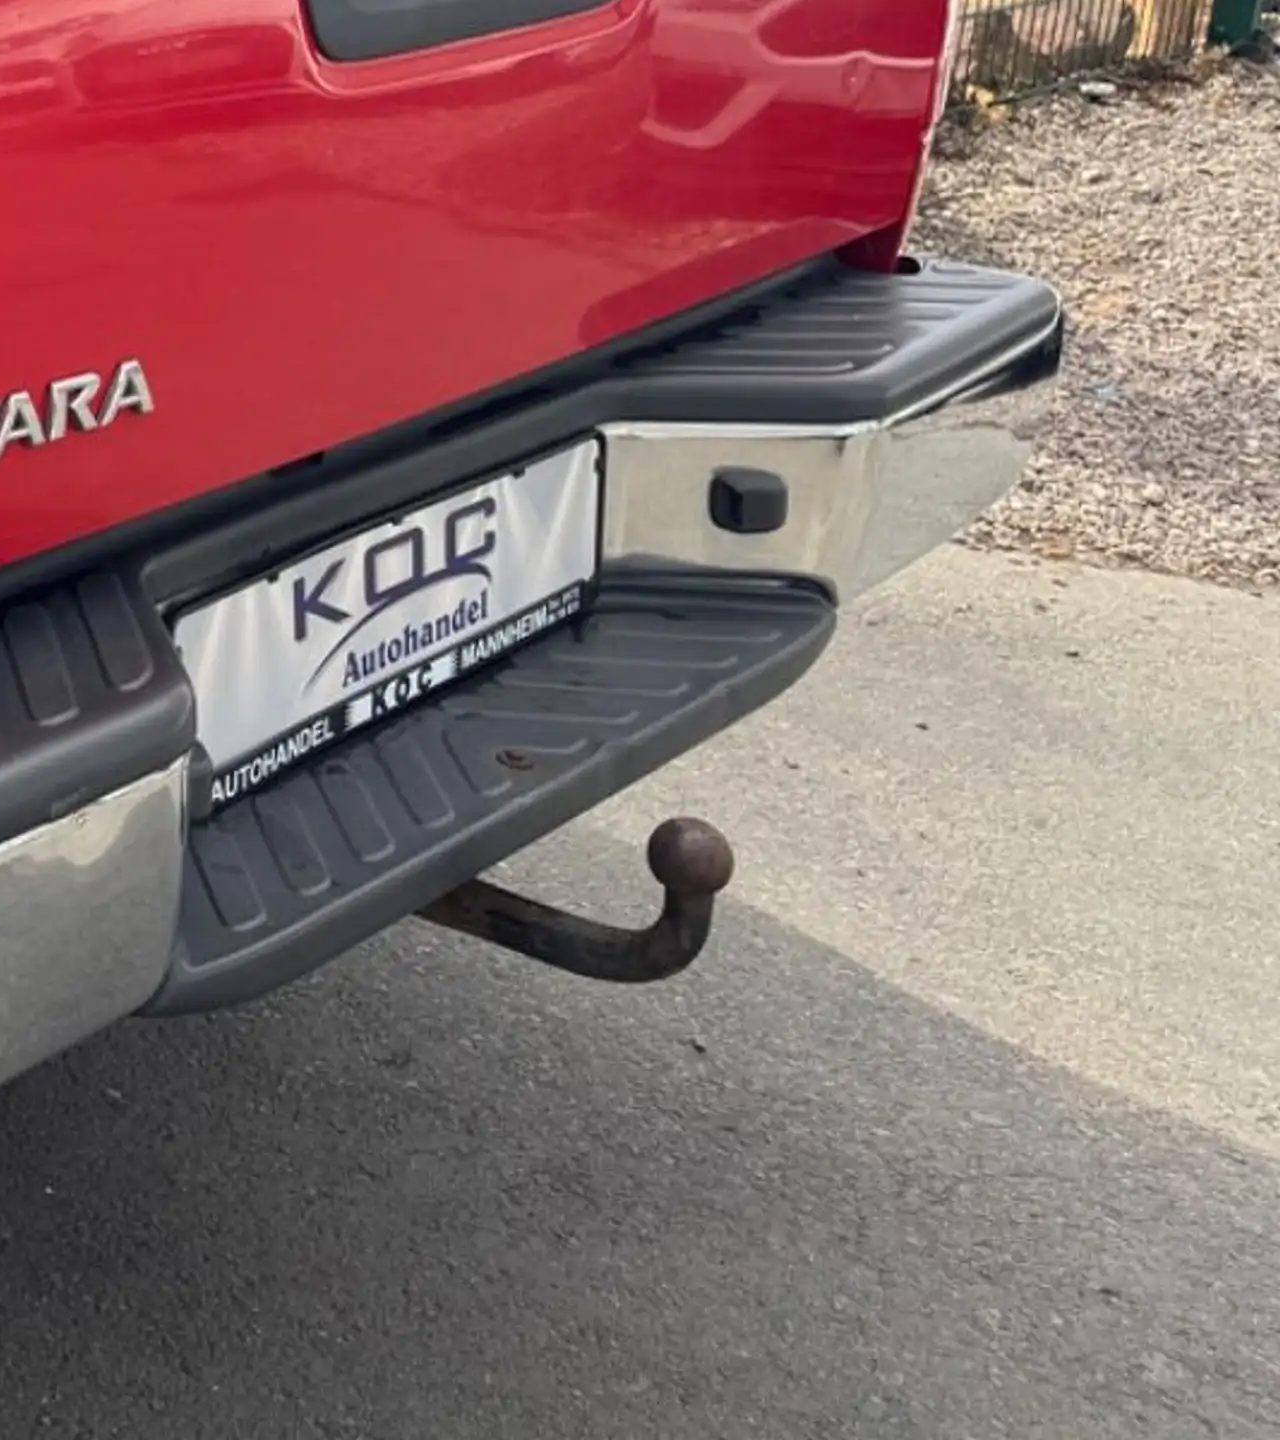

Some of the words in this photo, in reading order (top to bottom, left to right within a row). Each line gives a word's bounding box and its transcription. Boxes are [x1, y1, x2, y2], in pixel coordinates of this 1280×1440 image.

[211, 716, 336, 803] AUTOHANDEL
[461, 604, 547, 669] MANNHEIM
[342, 587, 489, 688] Autohandel
